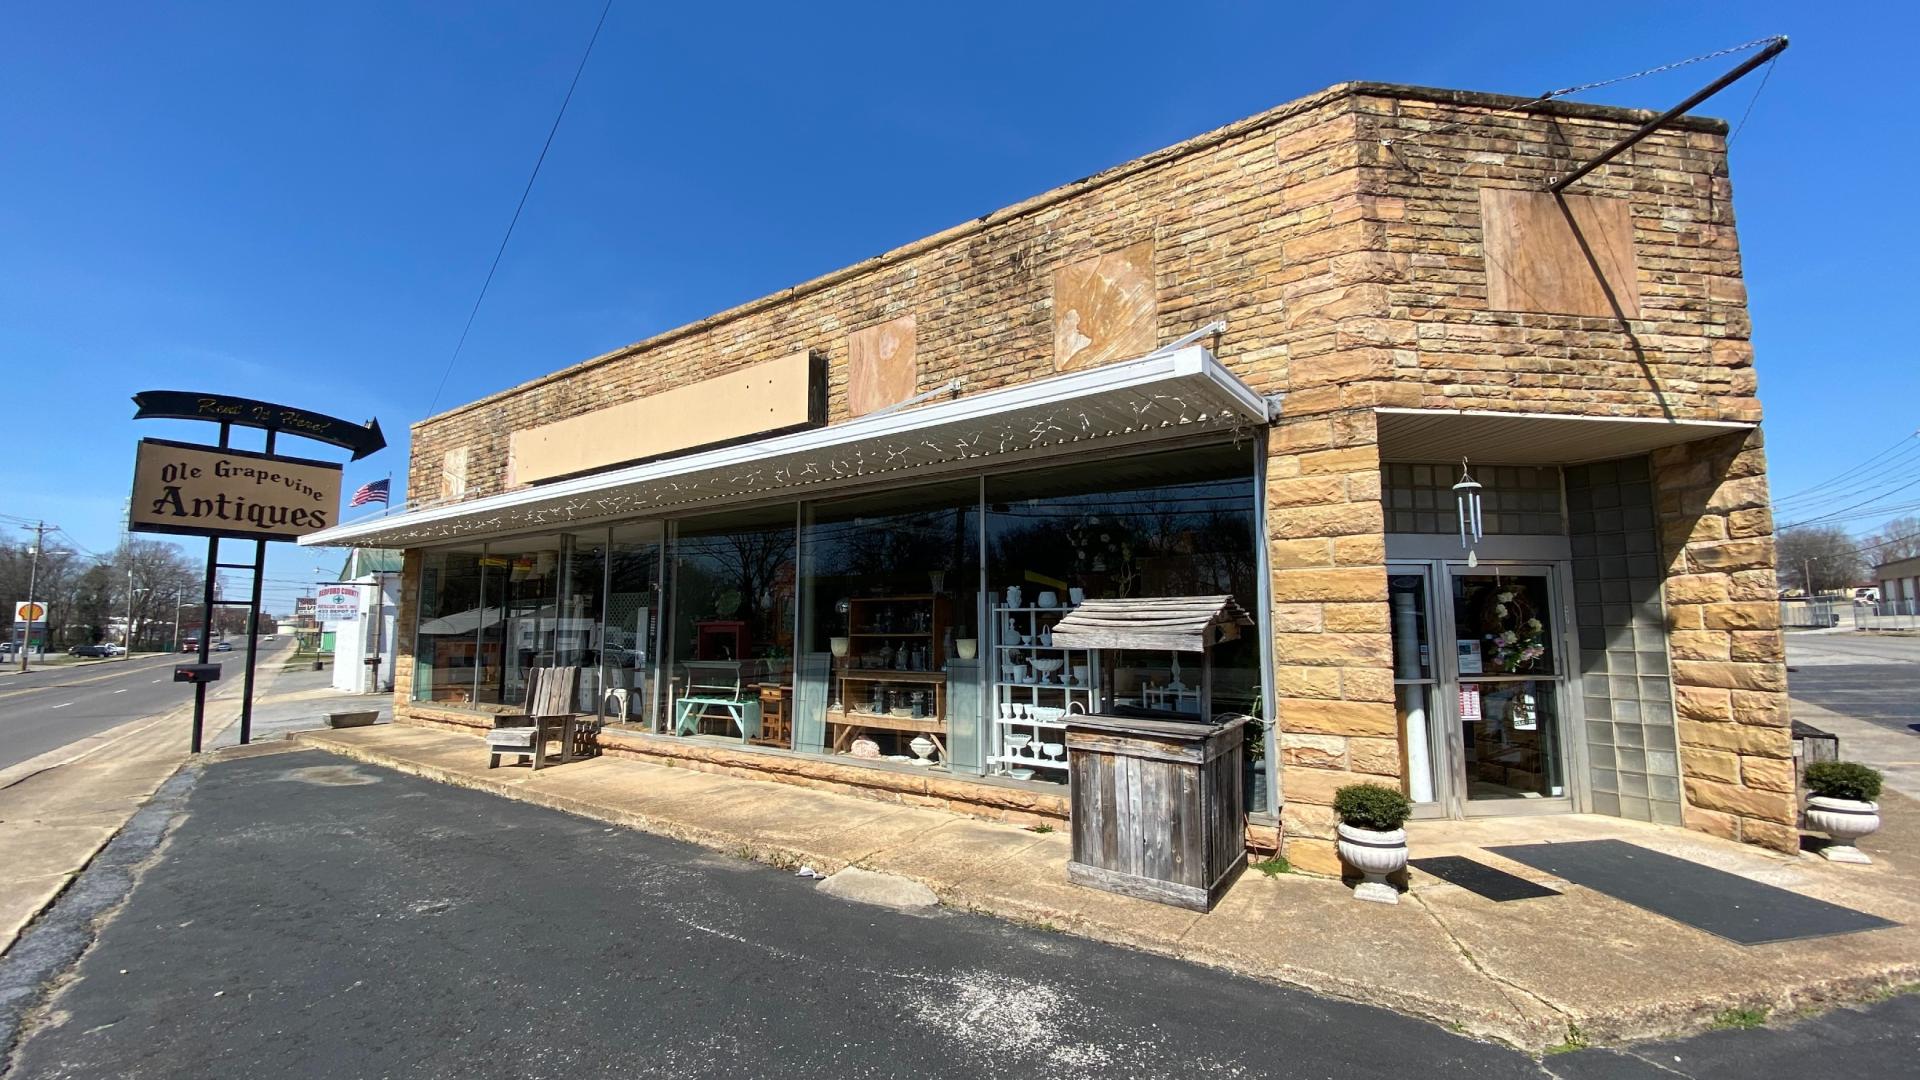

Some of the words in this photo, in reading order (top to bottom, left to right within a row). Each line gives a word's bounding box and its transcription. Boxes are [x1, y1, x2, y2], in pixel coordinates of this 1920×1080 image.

[162, 462, 202, 483] Ole
[215, 460, 324, 501] Grapevine
[152, 486, 328, 529] Antiques
